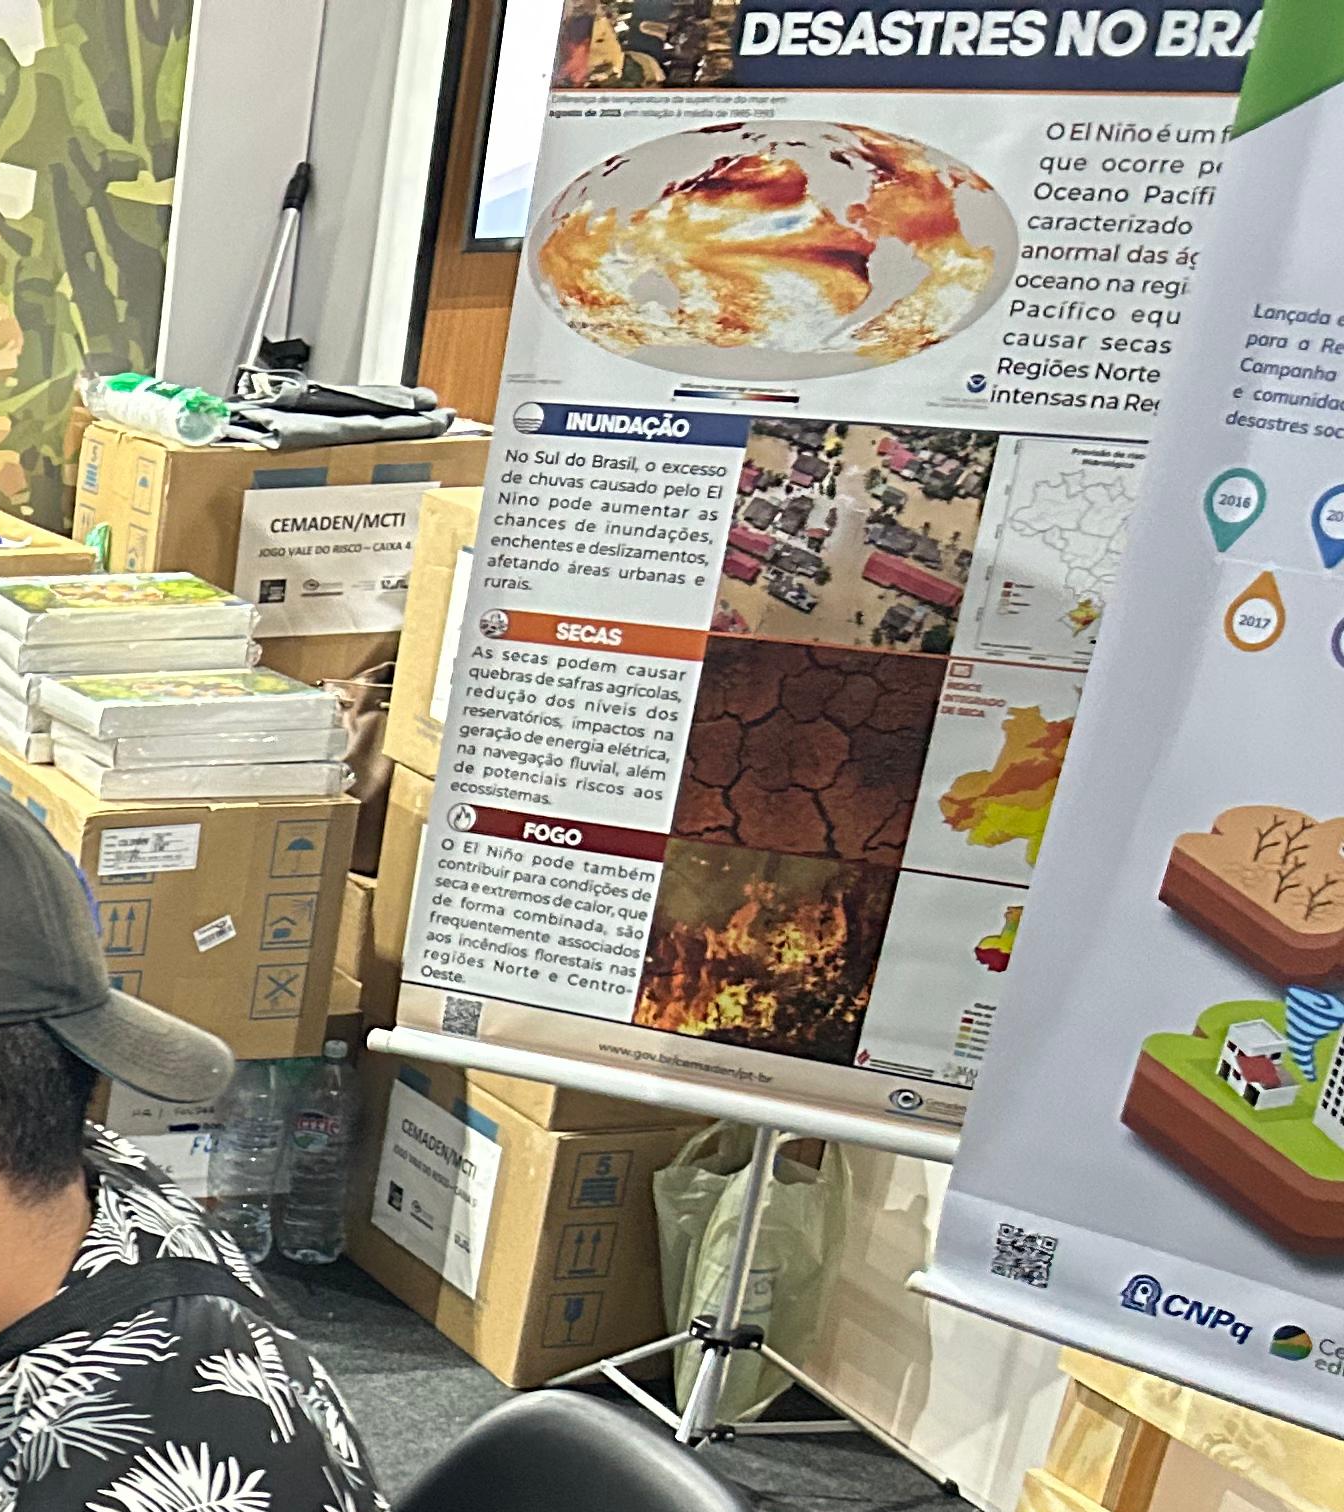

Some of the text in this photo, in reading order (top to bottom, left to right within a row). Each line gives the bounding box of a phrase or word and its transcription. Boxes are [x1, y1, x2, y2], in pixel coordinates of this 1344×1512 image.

[739, 10, 1047, 57] DESASTRES
[1054, 10, 1148, 57] NO
[1046, 122, 1065, 140] O
[1070, 122, 1091, 141] El
[1096, 123, 1152, 142] Niño
[1157, 124, 1171, 142] é
[1176, 128, 1214, 143] um
[1040, 155, 1087, 175] que
[1102, 157, 1184, 173] ocorre
[1033, 182, 1129, 203] Oceano
[1027, 214, 1193, 235] caracterizado
[1021, 245, 1168, 264] anormal das
[1015, 274, 1100, 291] oceano
[1106, 278, 1135, 292] na
[1010, 300, 1115, 321] Pacífico
[1253, 304, 1331, 326] Lançada
[1003, 332, 1172, 354] causar secas
[1245, 332, 1310, 351] para a
[997, 358, 1160, 383] Regiões Norte
[1240, 357, 1337, 382] Campanha
[990, 385, 1087, 407] intensas
[1091, 395, 1118, 409] na
[1233, 387, 1243, 399] e
[566, 412, 690, 439] INUNDAÇÃO
[1226, 411, 1308, 435] desastres
[505, 450, 728, 477] No Sul do Brasil, o excesso
[501, 472, 722, 499] de chuvas causado pelo El
[549, 496, 592, 511] pode
[601, 501, 689, 519] aumentar
[699, 509, 718, 521] as
[1218, 494, 1251, 508] 2016
[271, 513, 406, 533] CEMADEN/MCTI
[494, 514, 713, 544] chances de inundações,
[259, 548, 285, 558] JOGO
[289, 546, 313, 556] VALE
[315, 545, 330, 554] DO
[333, 544, 361, 553] RISCO
[373, 543, 401, 552] CAIXA
[491, 534, 709, 566] enchentes e deslizamentos,
[484, 576, 532, 590] rurais.
[487, 555, 704, 586] afetando áreas urbanas e
[556, 622, 622, 646] SECAS
[1239, 615, 1271, 629] 2017
[472, 646, 687, 681] As secas podem causar
[469, 665, 682, 703] quebras de safras agrícolas,
[466, 686, 678, 721] redução dos níveis dos
[463, 705, 673, 741] reservatórios, impactos na
[460, 725, 670, 763] geração de energia elétrica,
[457, 743, 666, 780] na navegação fluvial, além
[450, 781, 552, 805] ecossistemas.
[454, 761, 663, 800] de potenciais riscos aos
[523, 821, 582, 846] FOGO
[442, 838, 655, 882] O El Niño pode também
[438, 858, 652, 901] contribuir para condições de
[435, 877, 648, 923] seca e extremos de calor, que
[432, 895, 643, 939] de forma combinada, são
[430, 911, 640, 959] frequentemente associados
[426, 930, 636, 977] aos incêndios florestais nas
[421, 965, 466, 983] Oeste.
[424, 949, 633, 995] regiões Norte e Centro-
[1162, 1294, 1253, 1345] CNPq
